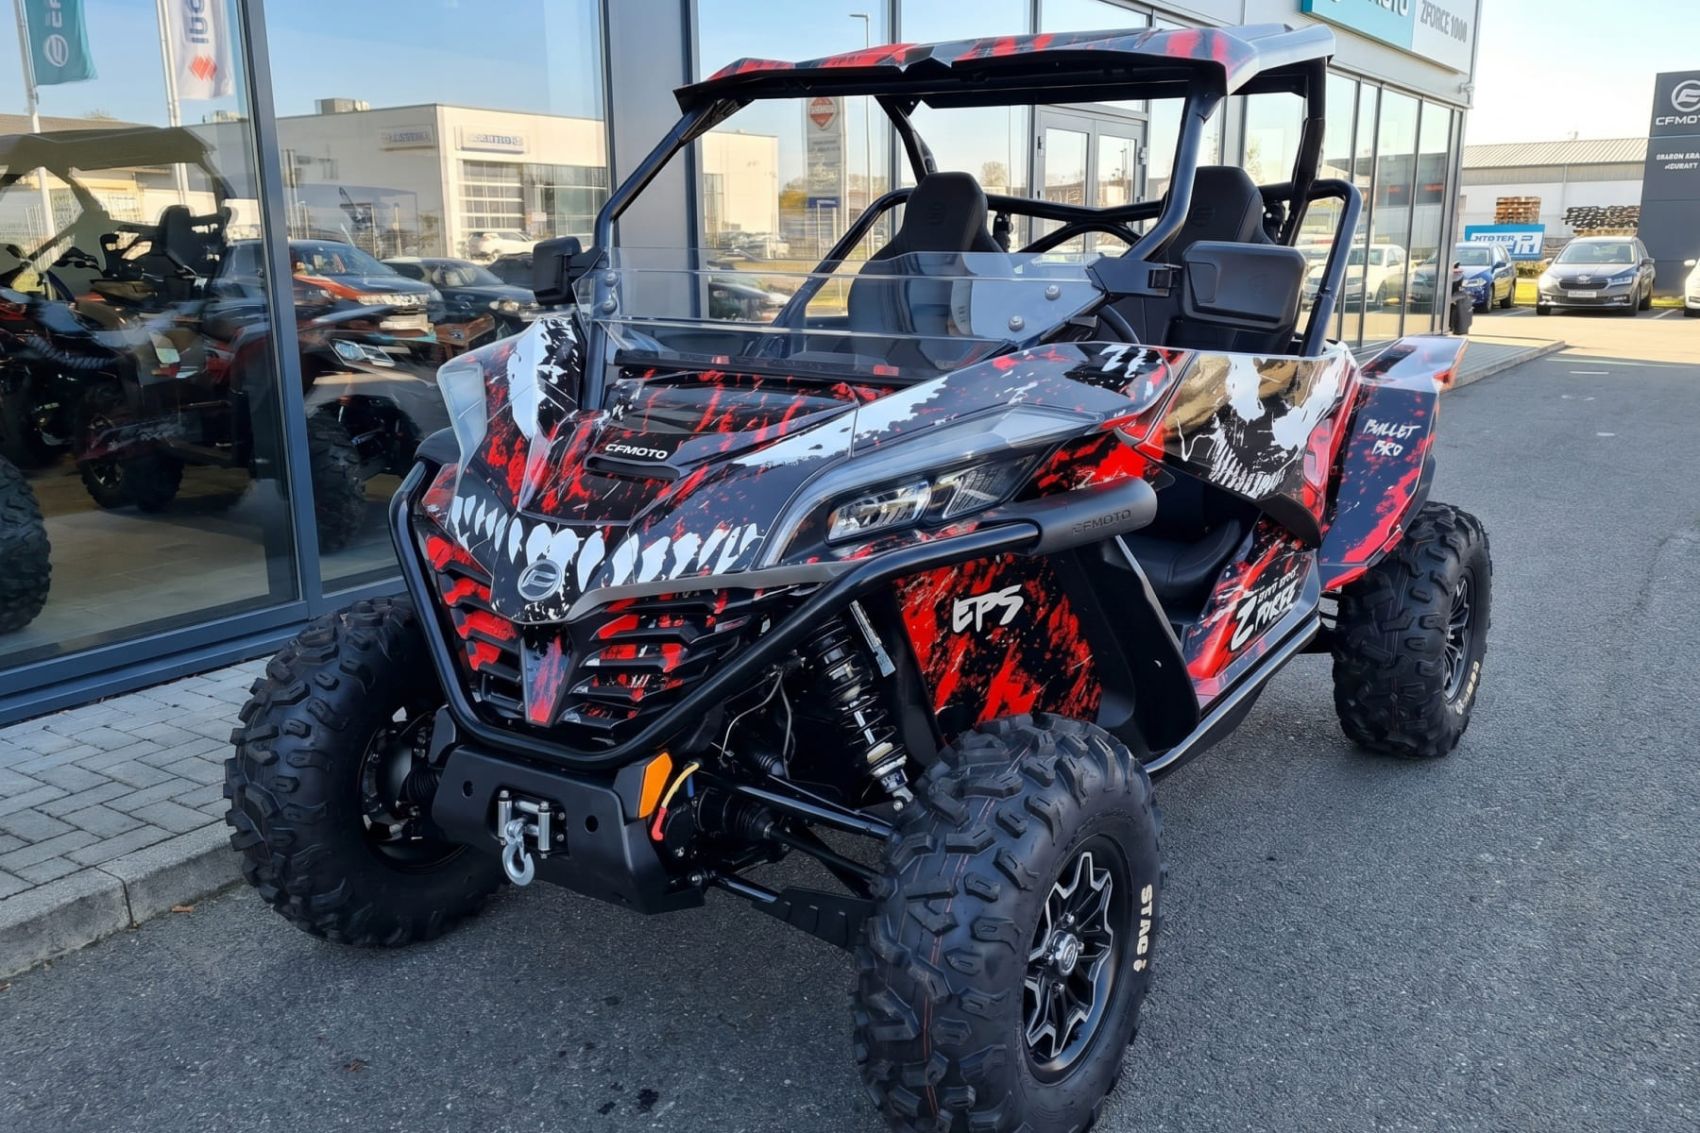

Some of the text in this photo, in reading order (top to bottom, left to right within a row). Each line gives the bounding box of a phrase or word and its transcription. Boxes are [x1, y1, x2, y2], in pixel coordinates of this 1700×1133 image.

[1655, 115, 1700, 126] CFMO
[1362, 418, 1422, 440] BULLET
[604, 443, 669, 460] CFMOTO
[1072, 509, 1133, 537] CFMOTO
[952, 583, 1025, 633] EPS
